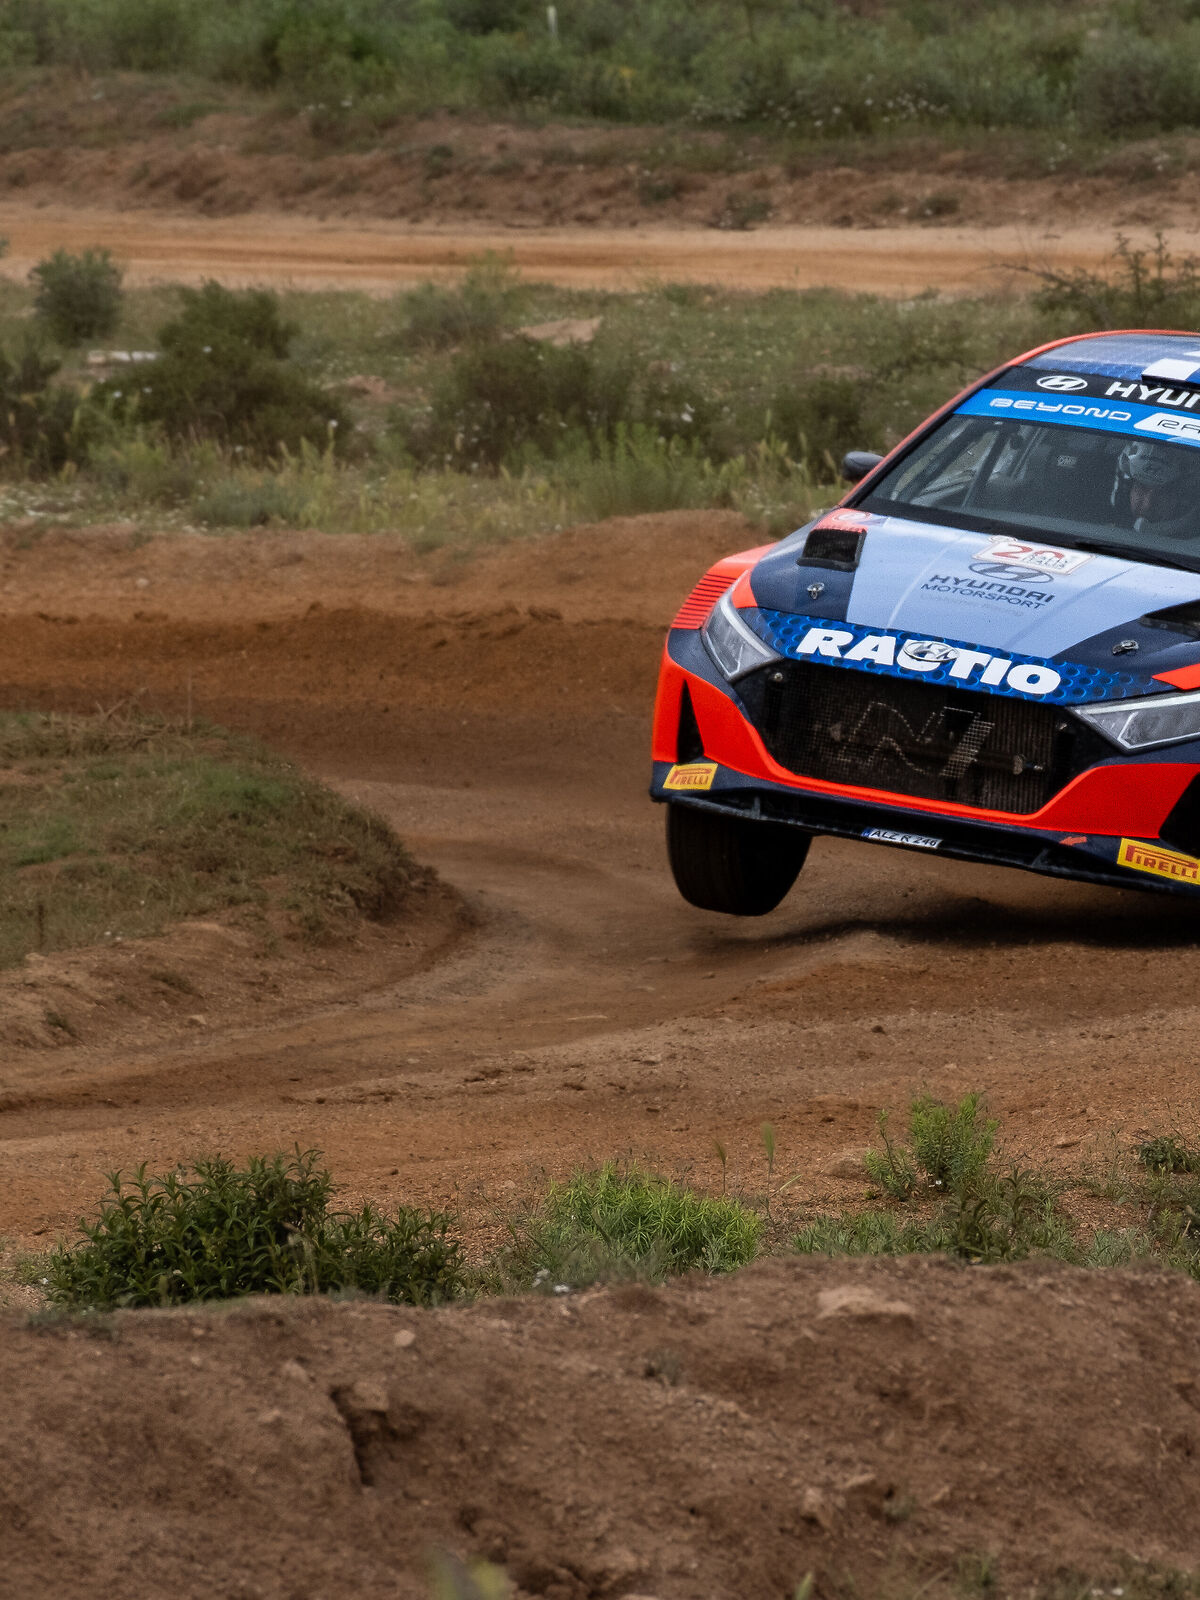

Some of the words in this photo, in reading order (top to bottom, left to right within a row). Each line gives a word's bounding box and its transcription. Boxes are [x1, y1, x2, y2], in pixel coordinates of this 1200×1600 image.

[989, 397, 1132, 422] BEYOND
[920, 583, 1047, 610] MOTORSPORT
[928, 574, 1057, 603] HYUNDAI
[1124, 844, 1199, 879] PIRELLI
